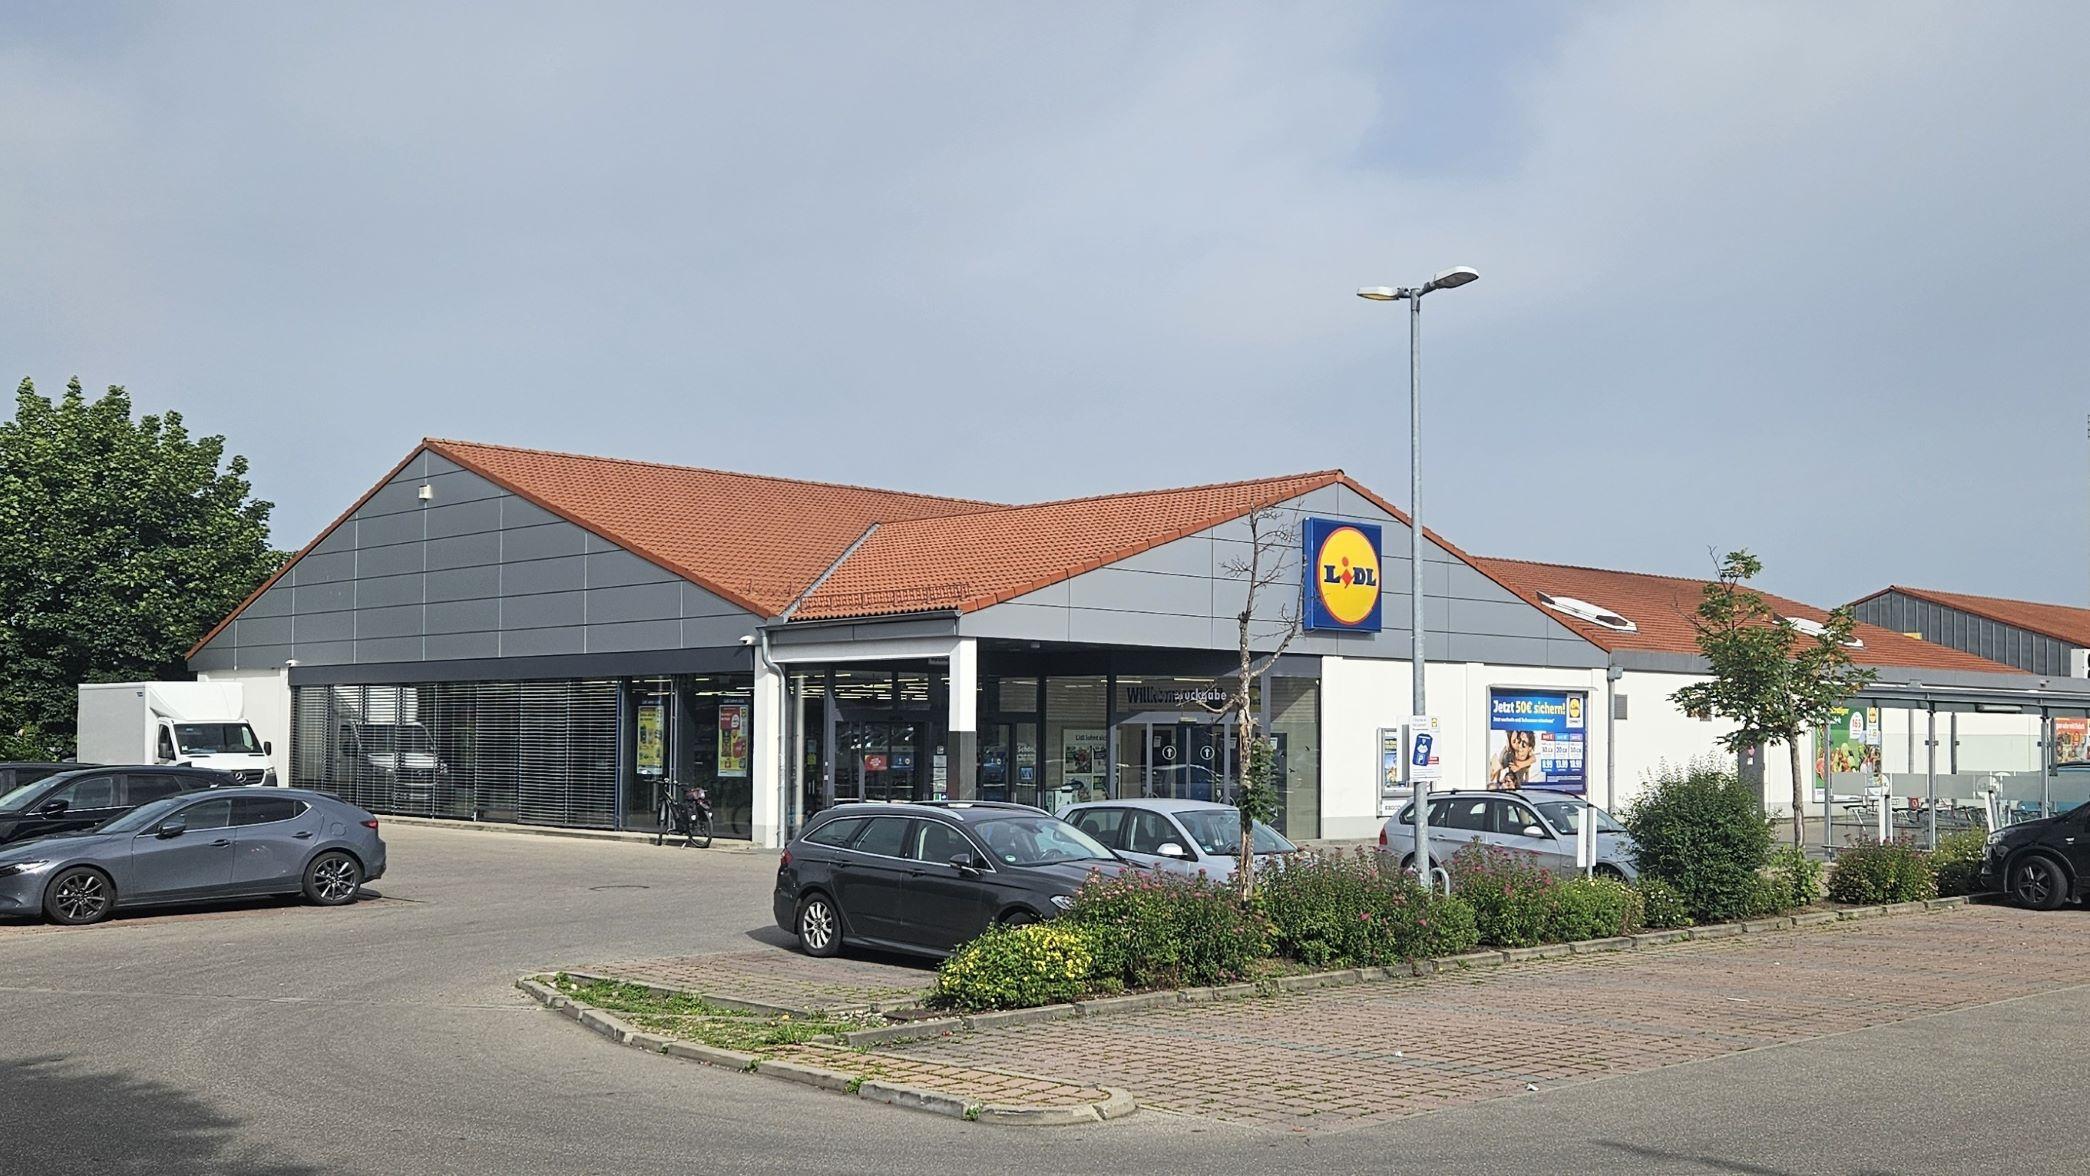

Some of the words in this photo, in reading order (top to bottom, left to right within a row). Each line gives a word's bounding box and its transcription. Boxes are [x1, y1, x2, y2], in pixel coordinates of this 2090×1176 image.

[1492, 699, 1515, 714] Jetzt
[1515, 700, 1533, 714] 50€
[1533, 701, 1566, 715] sichern!
